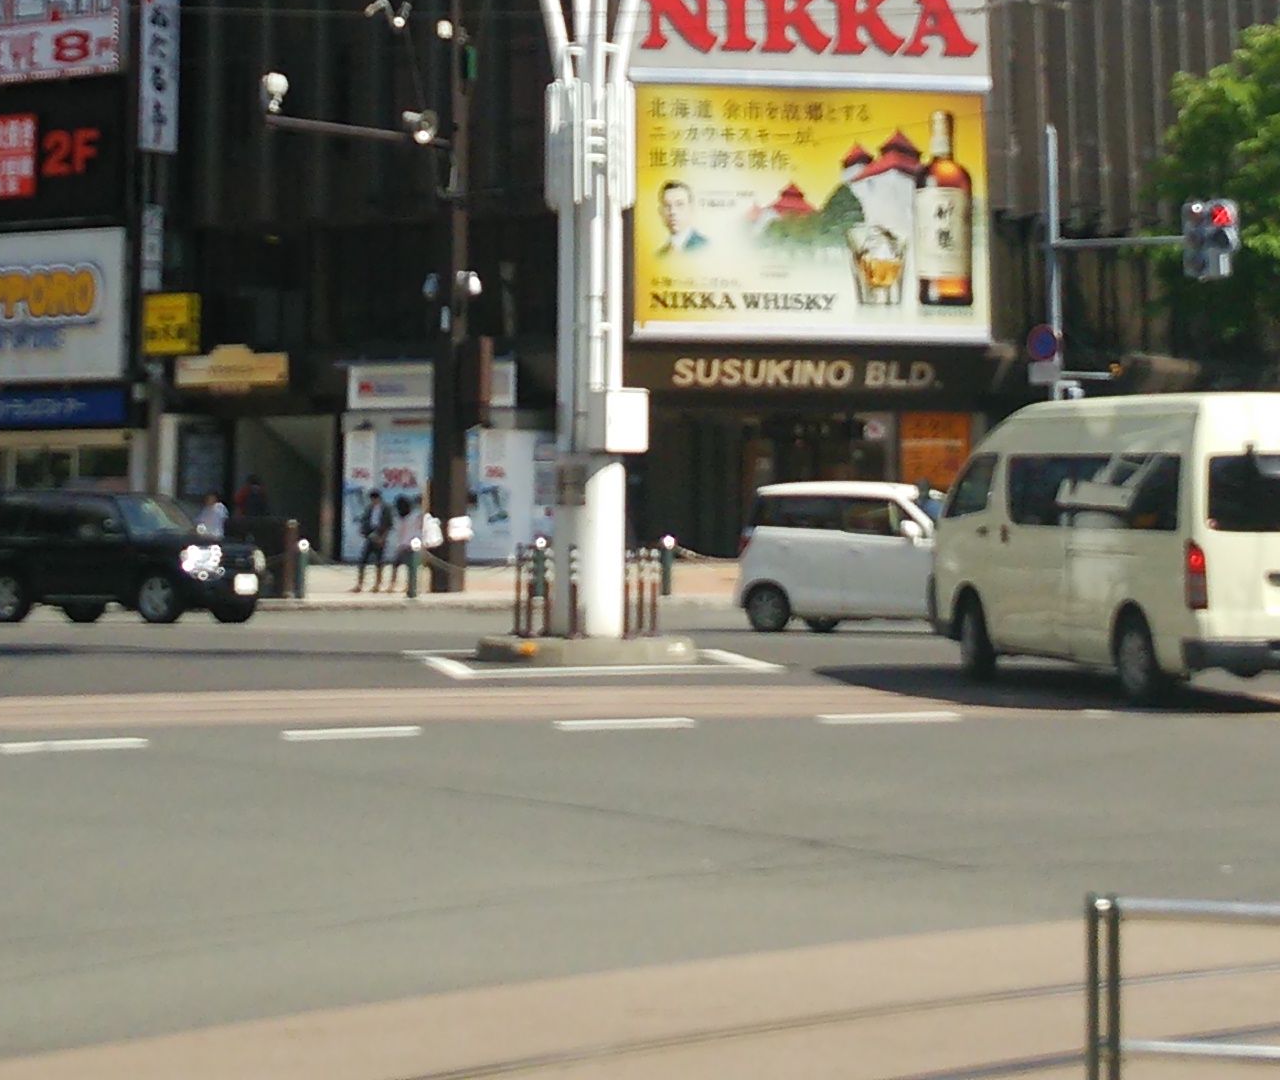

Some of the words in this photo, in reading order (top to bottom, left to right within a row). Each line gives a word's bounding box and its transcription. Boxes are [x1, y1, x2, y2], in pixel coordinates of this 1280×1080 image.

[41, 127, 101, 178] 2F
[648, 290, 737, 312] NIKKA
[742, 291, 840, 312] WHISKY
[672, 357, 854, 389] SUSUKINO
[866, 357, 943, 389] BLD.
